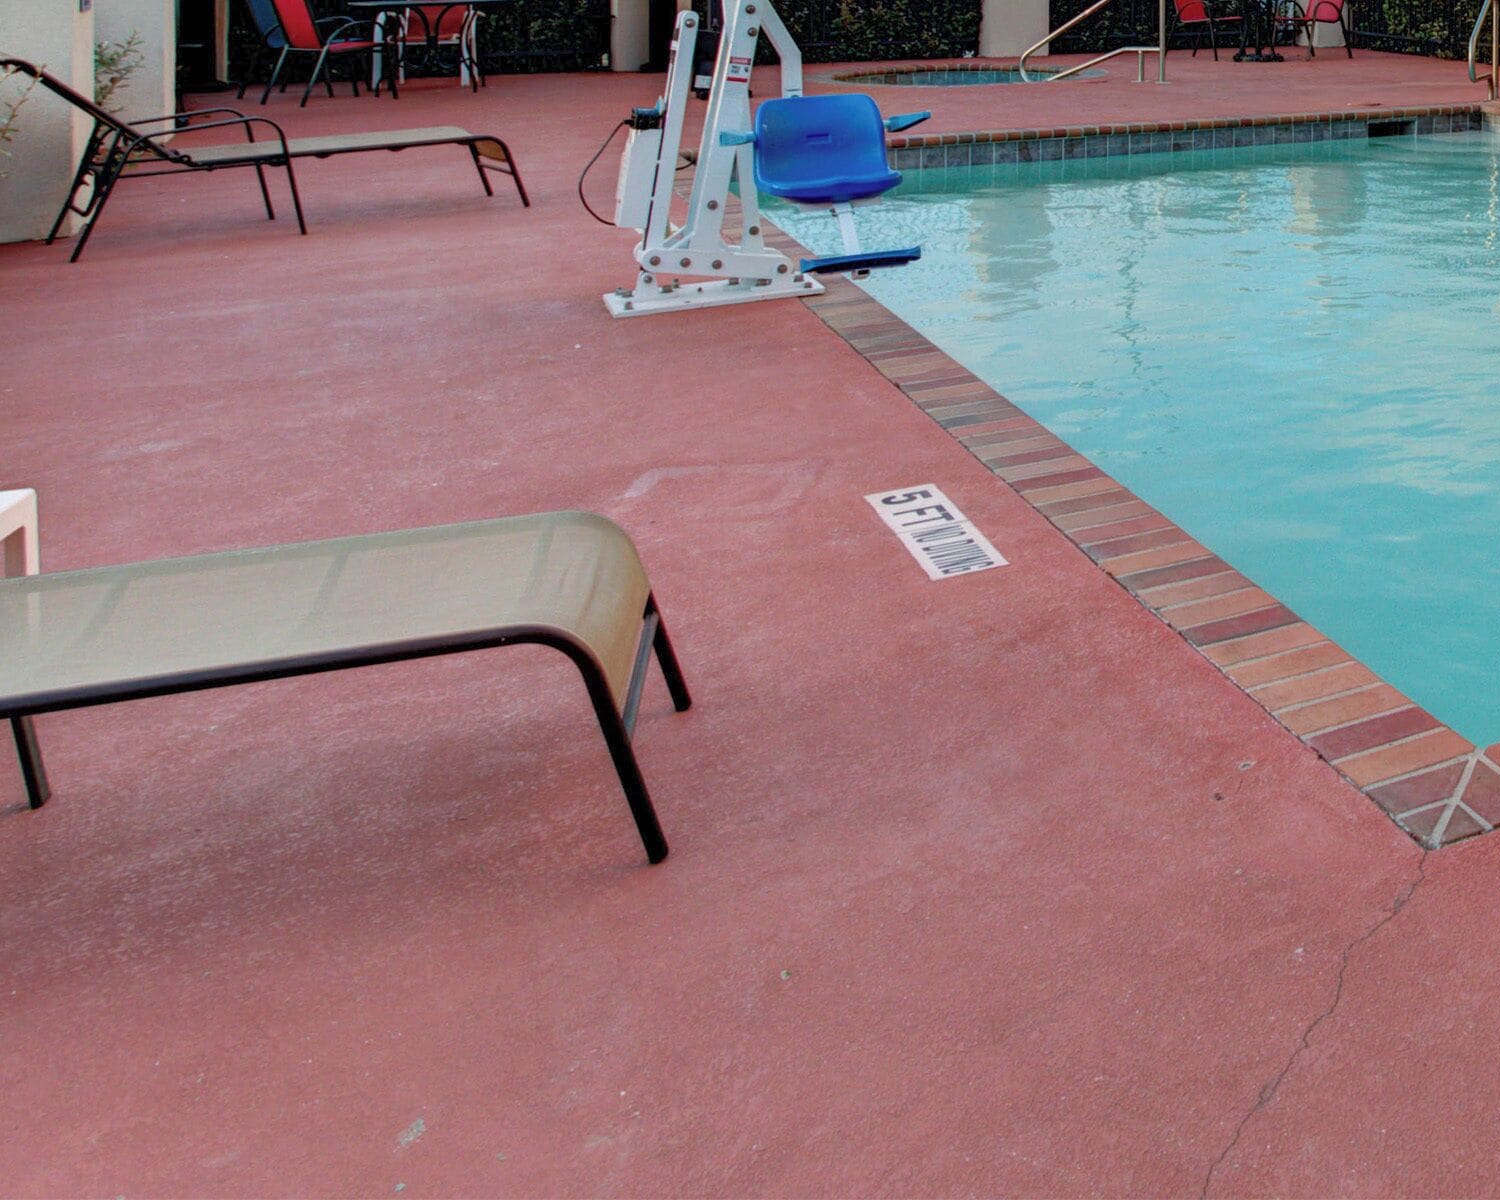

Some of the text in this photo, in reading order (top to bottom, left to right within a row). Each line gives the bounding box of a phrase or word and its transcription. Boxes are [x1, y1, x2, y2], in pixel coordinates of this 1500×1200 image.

[881, 490, 995, 575] 5 FT NO DIVING
